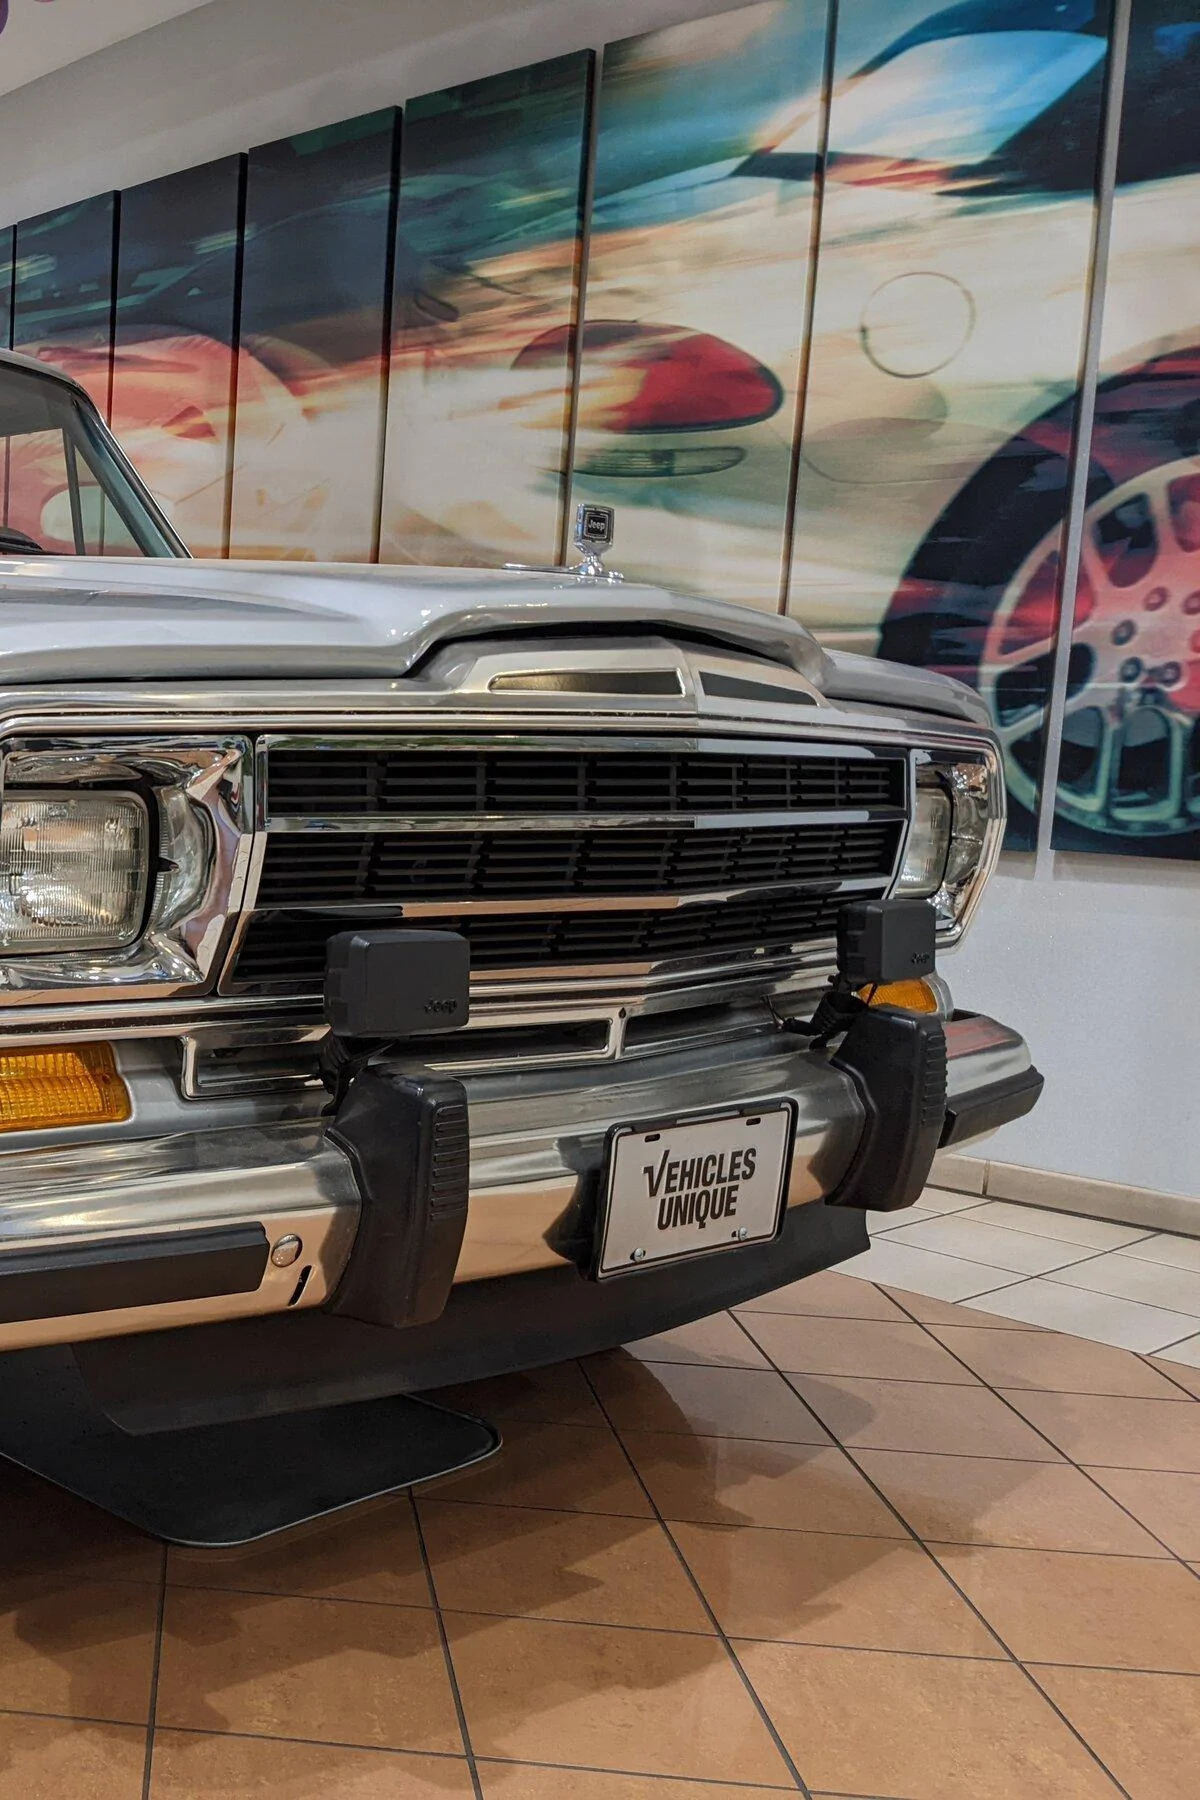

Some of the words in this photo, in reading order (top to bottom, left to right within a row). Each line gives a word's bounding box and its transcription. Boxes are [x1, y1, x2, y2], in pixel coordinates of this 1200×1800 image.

[588, 520, 605, 531] Jeep
[424, 998, 457, 1015] Jeep
[643, 1148, 757, 1198] VEHICLES
[657, 1184, 739, 1230] UNIQUE
